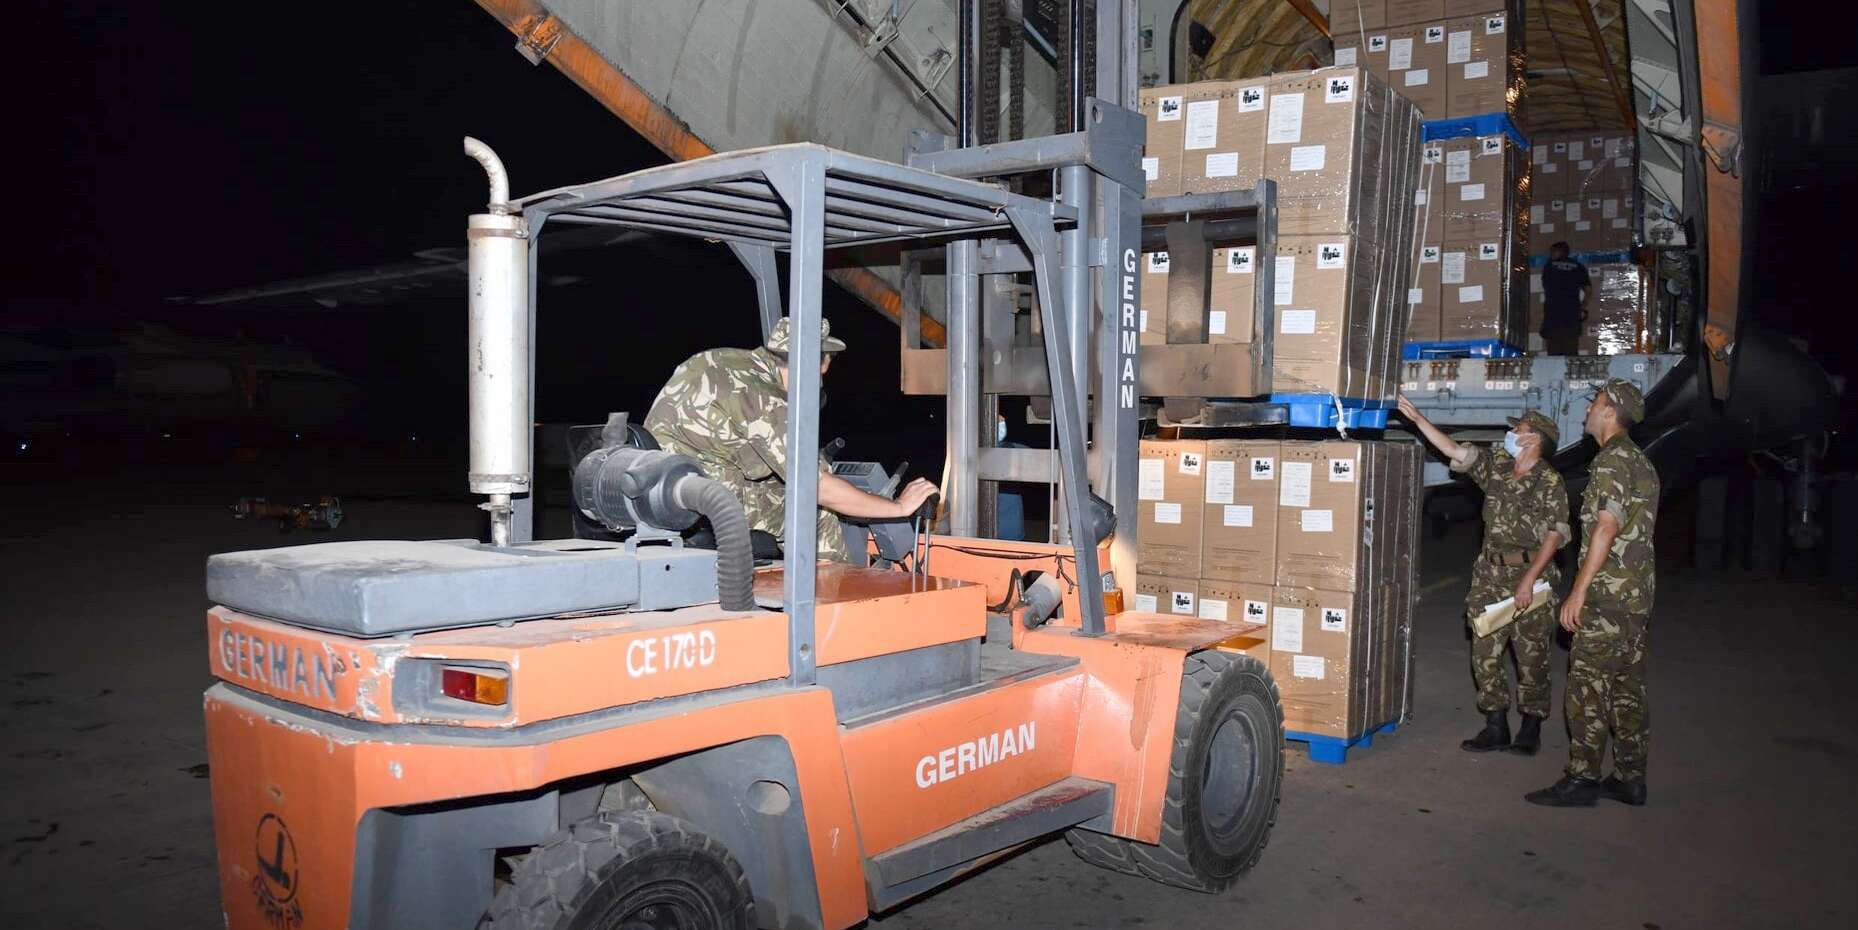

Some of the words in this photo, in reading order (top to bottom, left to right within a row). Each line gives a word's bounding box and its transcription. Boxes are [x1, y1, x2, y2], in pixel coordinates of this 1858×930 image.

[1121, 248, 1137, 409] GERMAN
[219, 627, 337, 700] GERMAN
[626, 637, 657, 678] CE
[915, 720, 1036, 789] GERMAN
